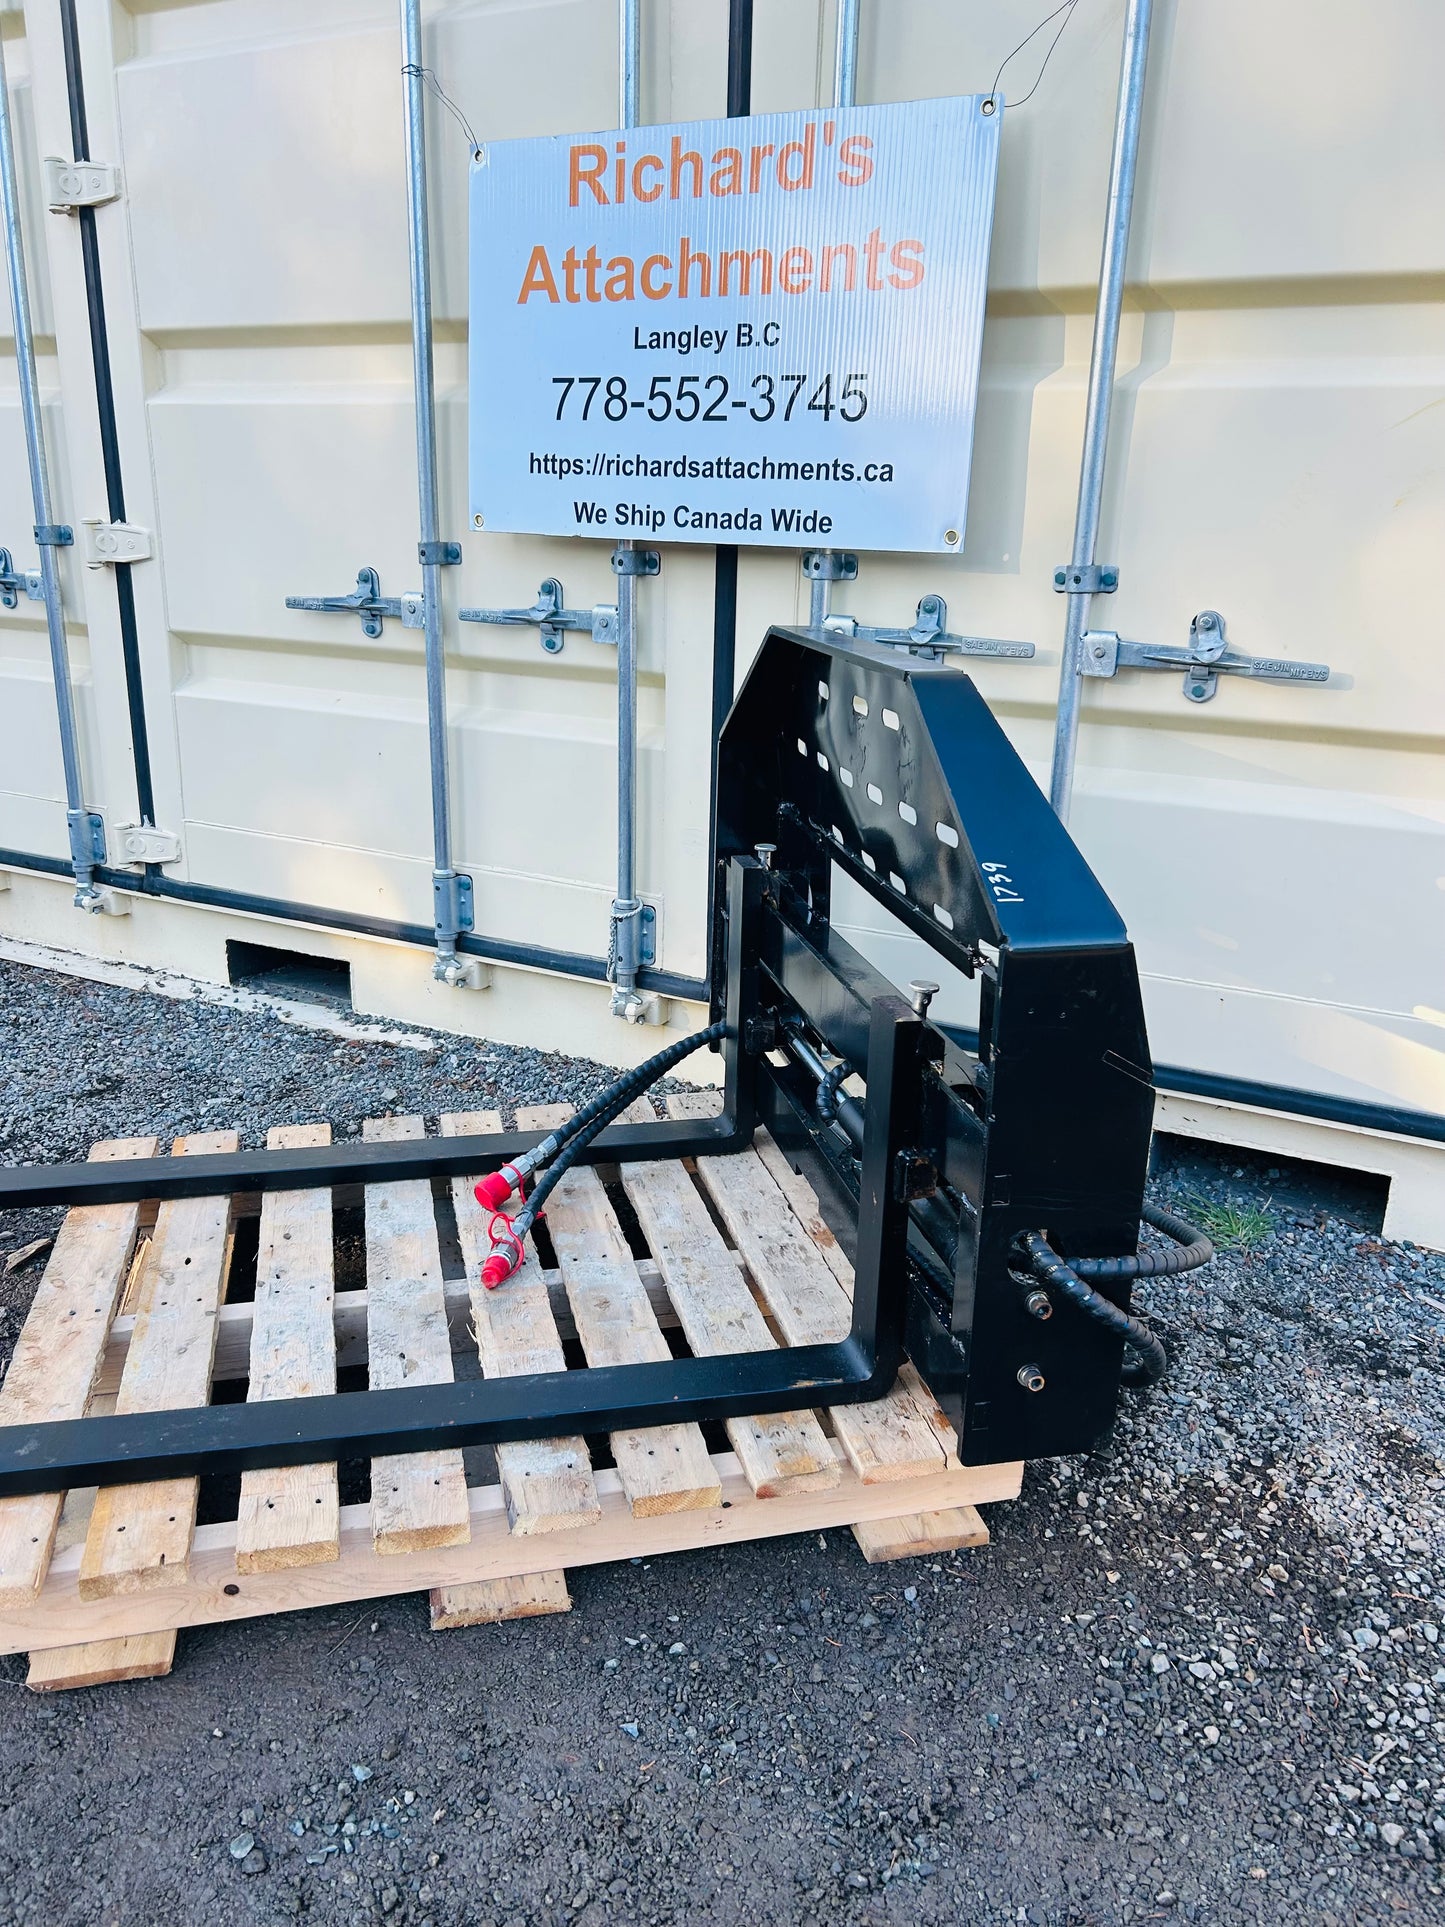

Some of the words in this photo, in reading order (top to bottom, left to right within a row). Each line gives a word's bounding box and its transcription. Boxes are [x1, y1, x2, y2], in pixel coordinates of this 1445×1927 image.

[569, 121, 875, 207] Richard's
[517, 226, 926, 305] Attachments
[634, 325, 728, 355] Langley
[736, 321, 781, 348] B.C
[552, 373, 869, 423] 778-552-3745
[529, 452, 894, 482] https://richardsattachments.ca
[573, 501, 608, 525] We
[614, 503, 666, 532] Ship
[673, 505, 763, 531] Canada
[771, 508, 833, 534] Wide
[981, 862, 1024, 903] 1739
